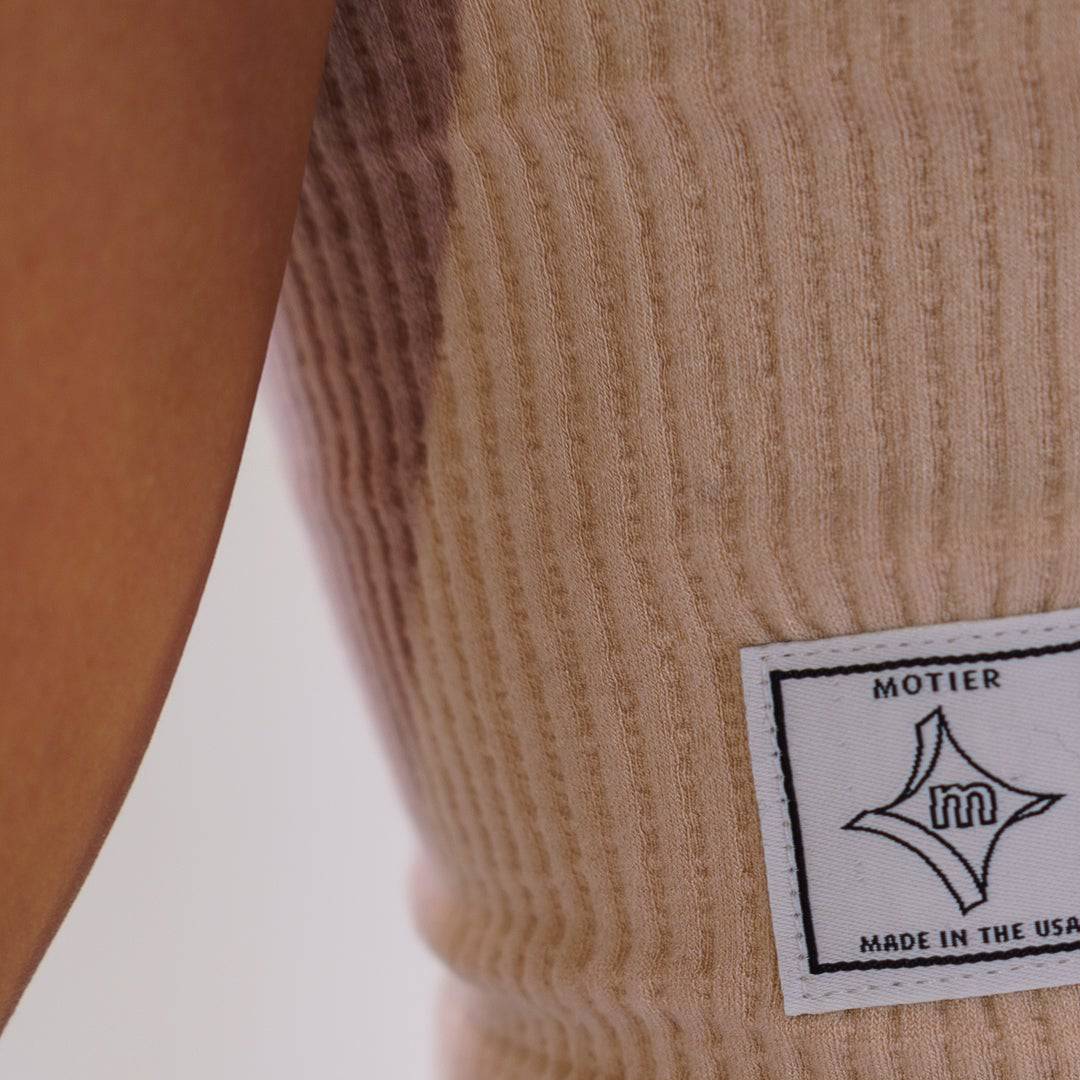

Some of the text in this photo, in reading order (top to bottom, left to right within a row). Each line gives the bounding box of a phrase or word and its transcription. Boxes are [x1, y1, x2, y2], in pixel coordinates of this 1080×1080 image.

[873, 668, 1001, 699] MOTIER
[929, 782, 998, 830] m
[860, 932, 931, 954] MADE
[940, 929, 968, 949] IN
[978, 923, 1026, 944] THE
